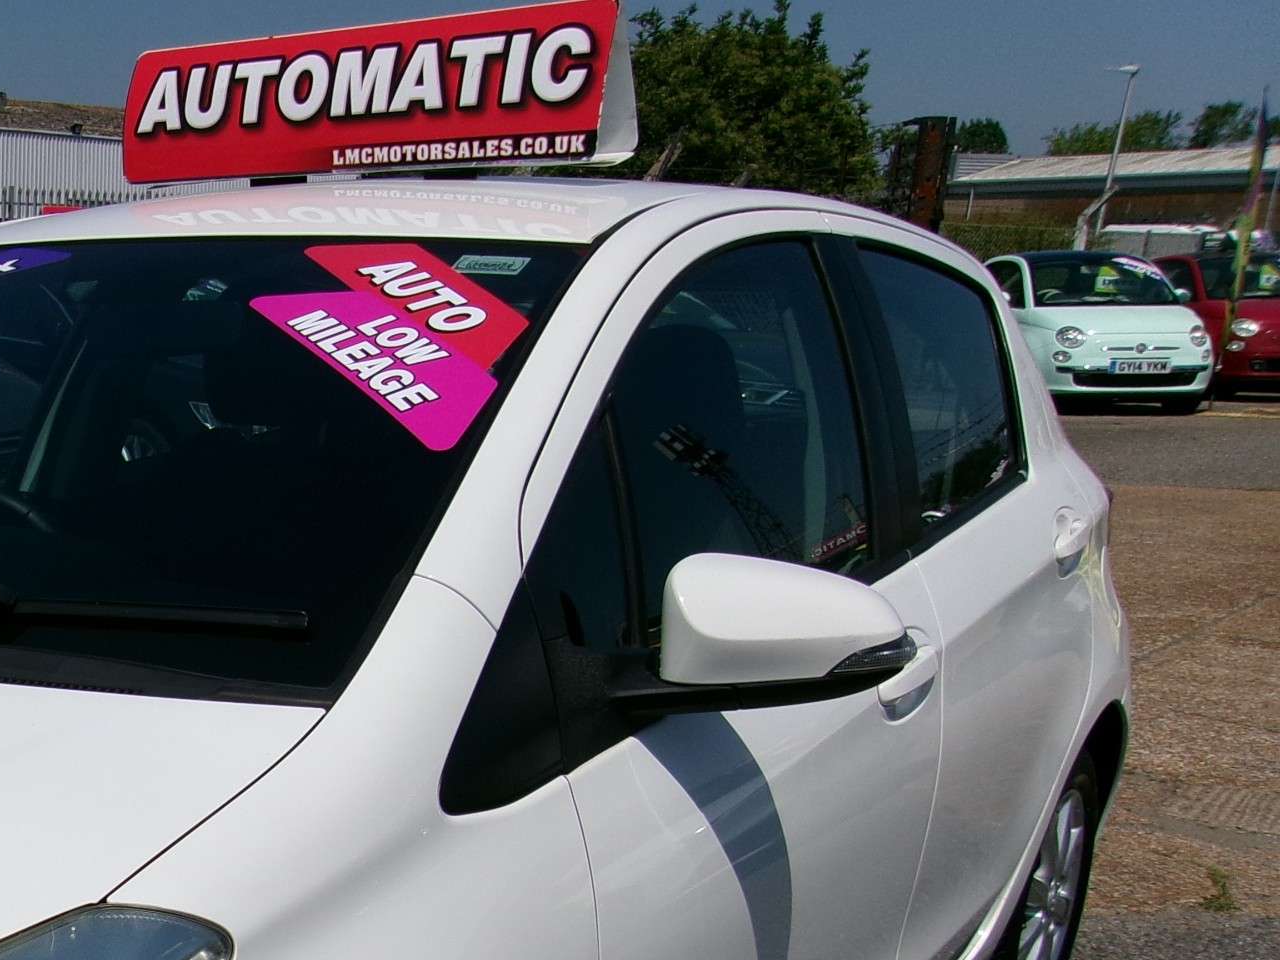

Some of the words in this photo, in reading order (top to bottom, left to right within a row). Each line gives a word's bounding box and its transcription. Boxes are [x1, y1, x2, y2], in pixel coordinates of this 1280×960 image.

[136, 26, 593, 134] AUTOMATIC
[332, 134, 586, 167] LMCMOTORSALES.CO.UK
[357, 261, 487, 333] AUTO
[286, 309, 440, 412] MILEAGE
[355, 314, 452, 367] LOW
[1119, 361, 1143, 372] GY14
